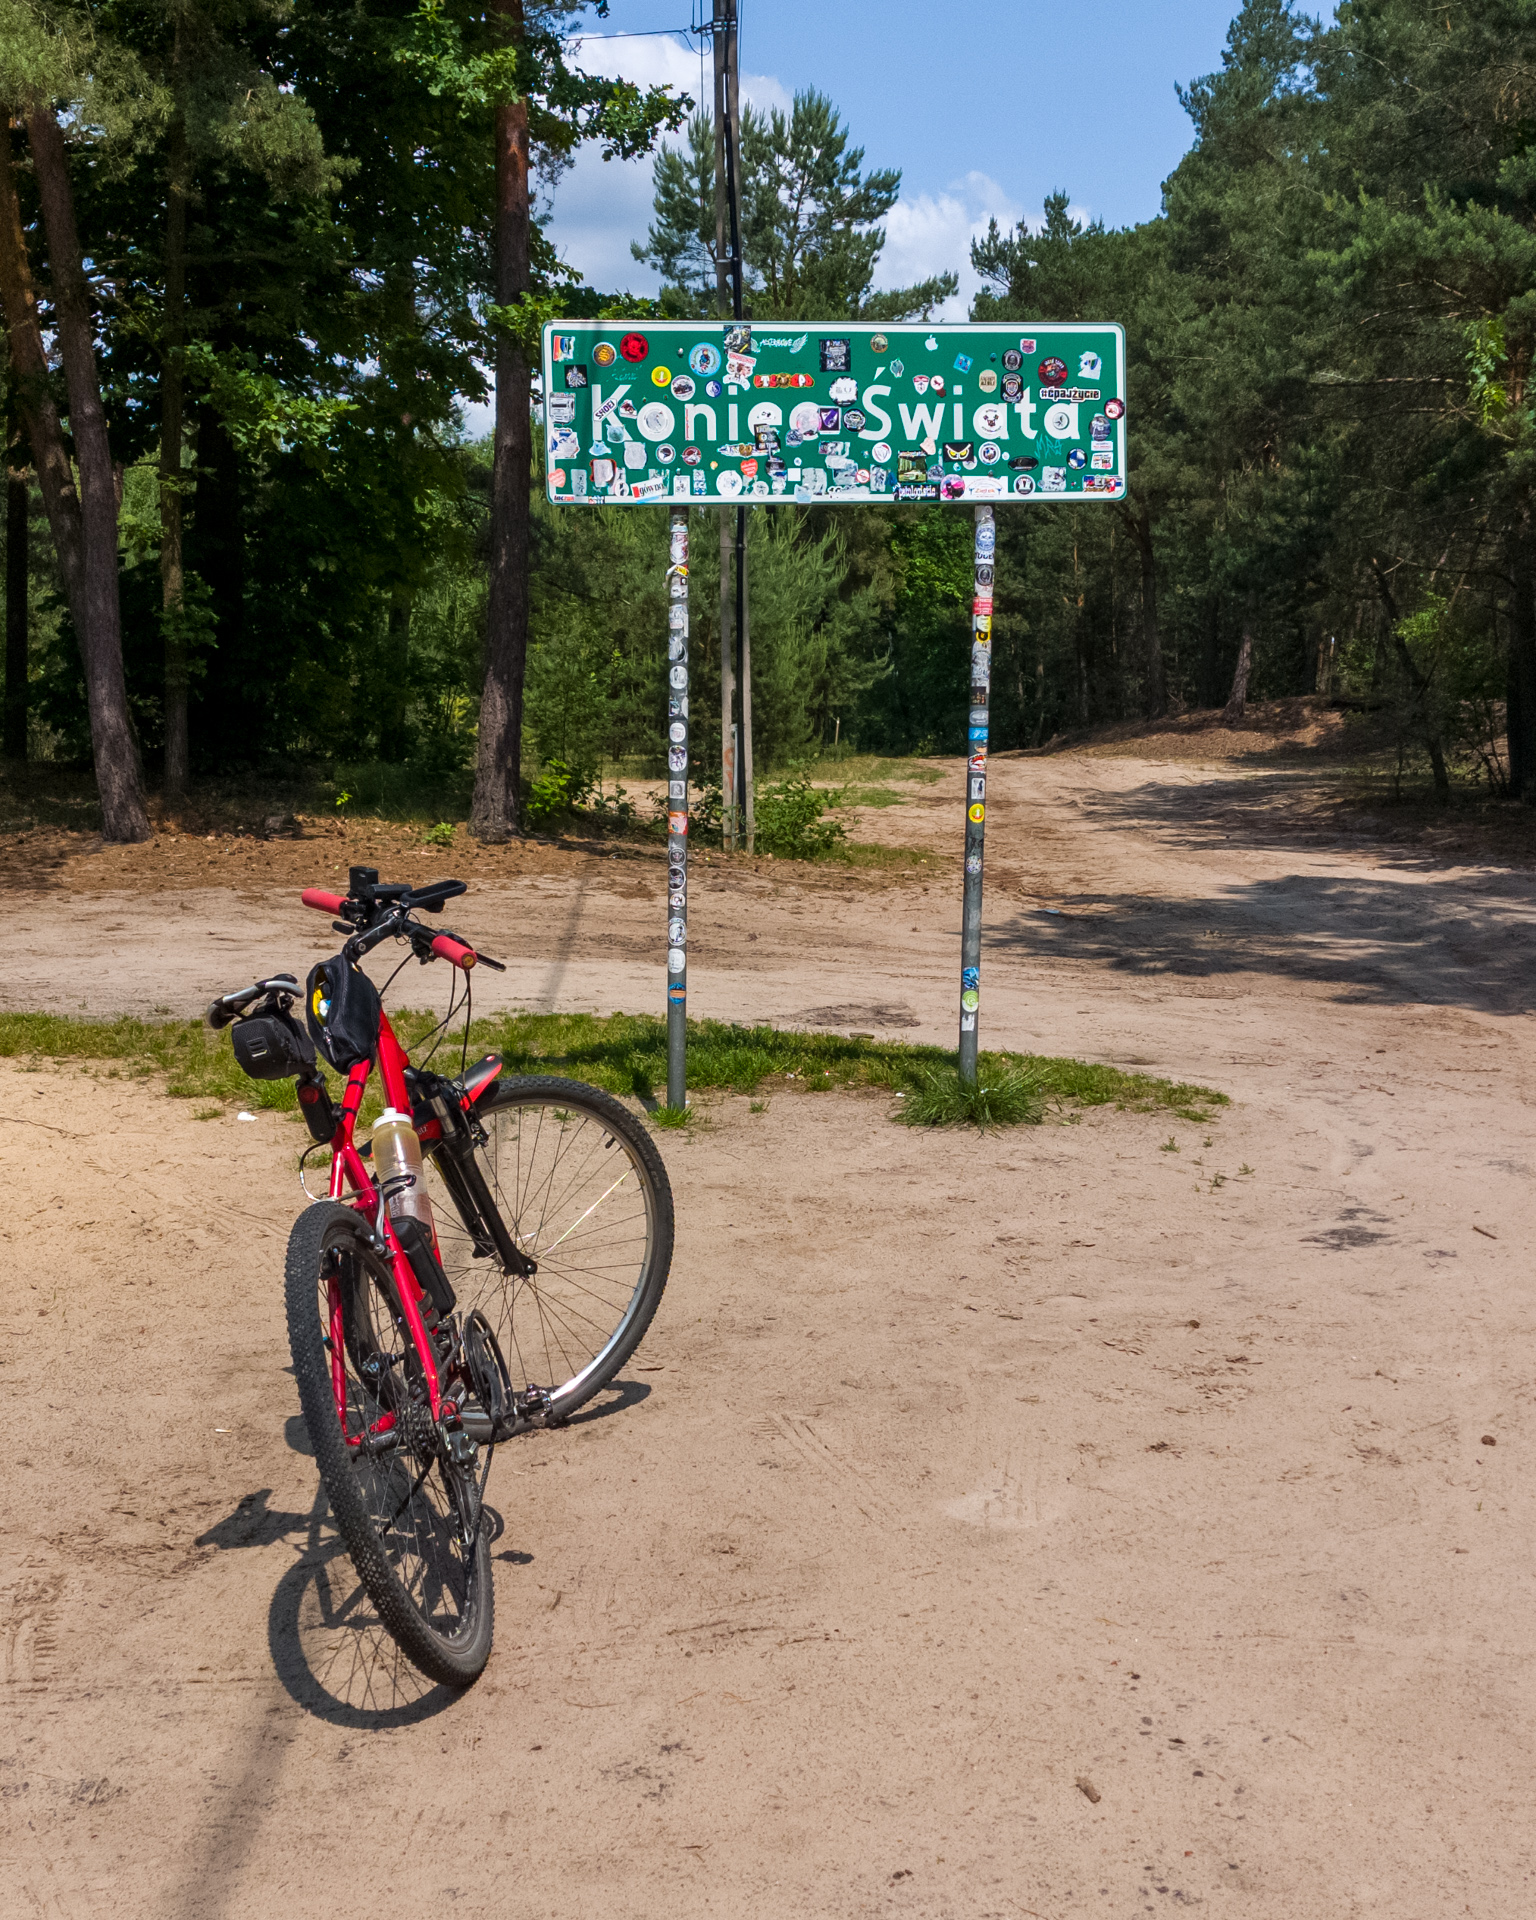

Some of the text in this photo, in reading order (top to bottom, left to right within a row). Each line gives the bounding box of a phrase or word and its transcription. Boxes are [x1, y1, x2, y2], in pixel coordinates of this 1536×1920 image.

[592, 384, 820, 441] Koniec
[858, 367, 1080, 441] Świata
[595, 400, 615, 419] SHOEI
